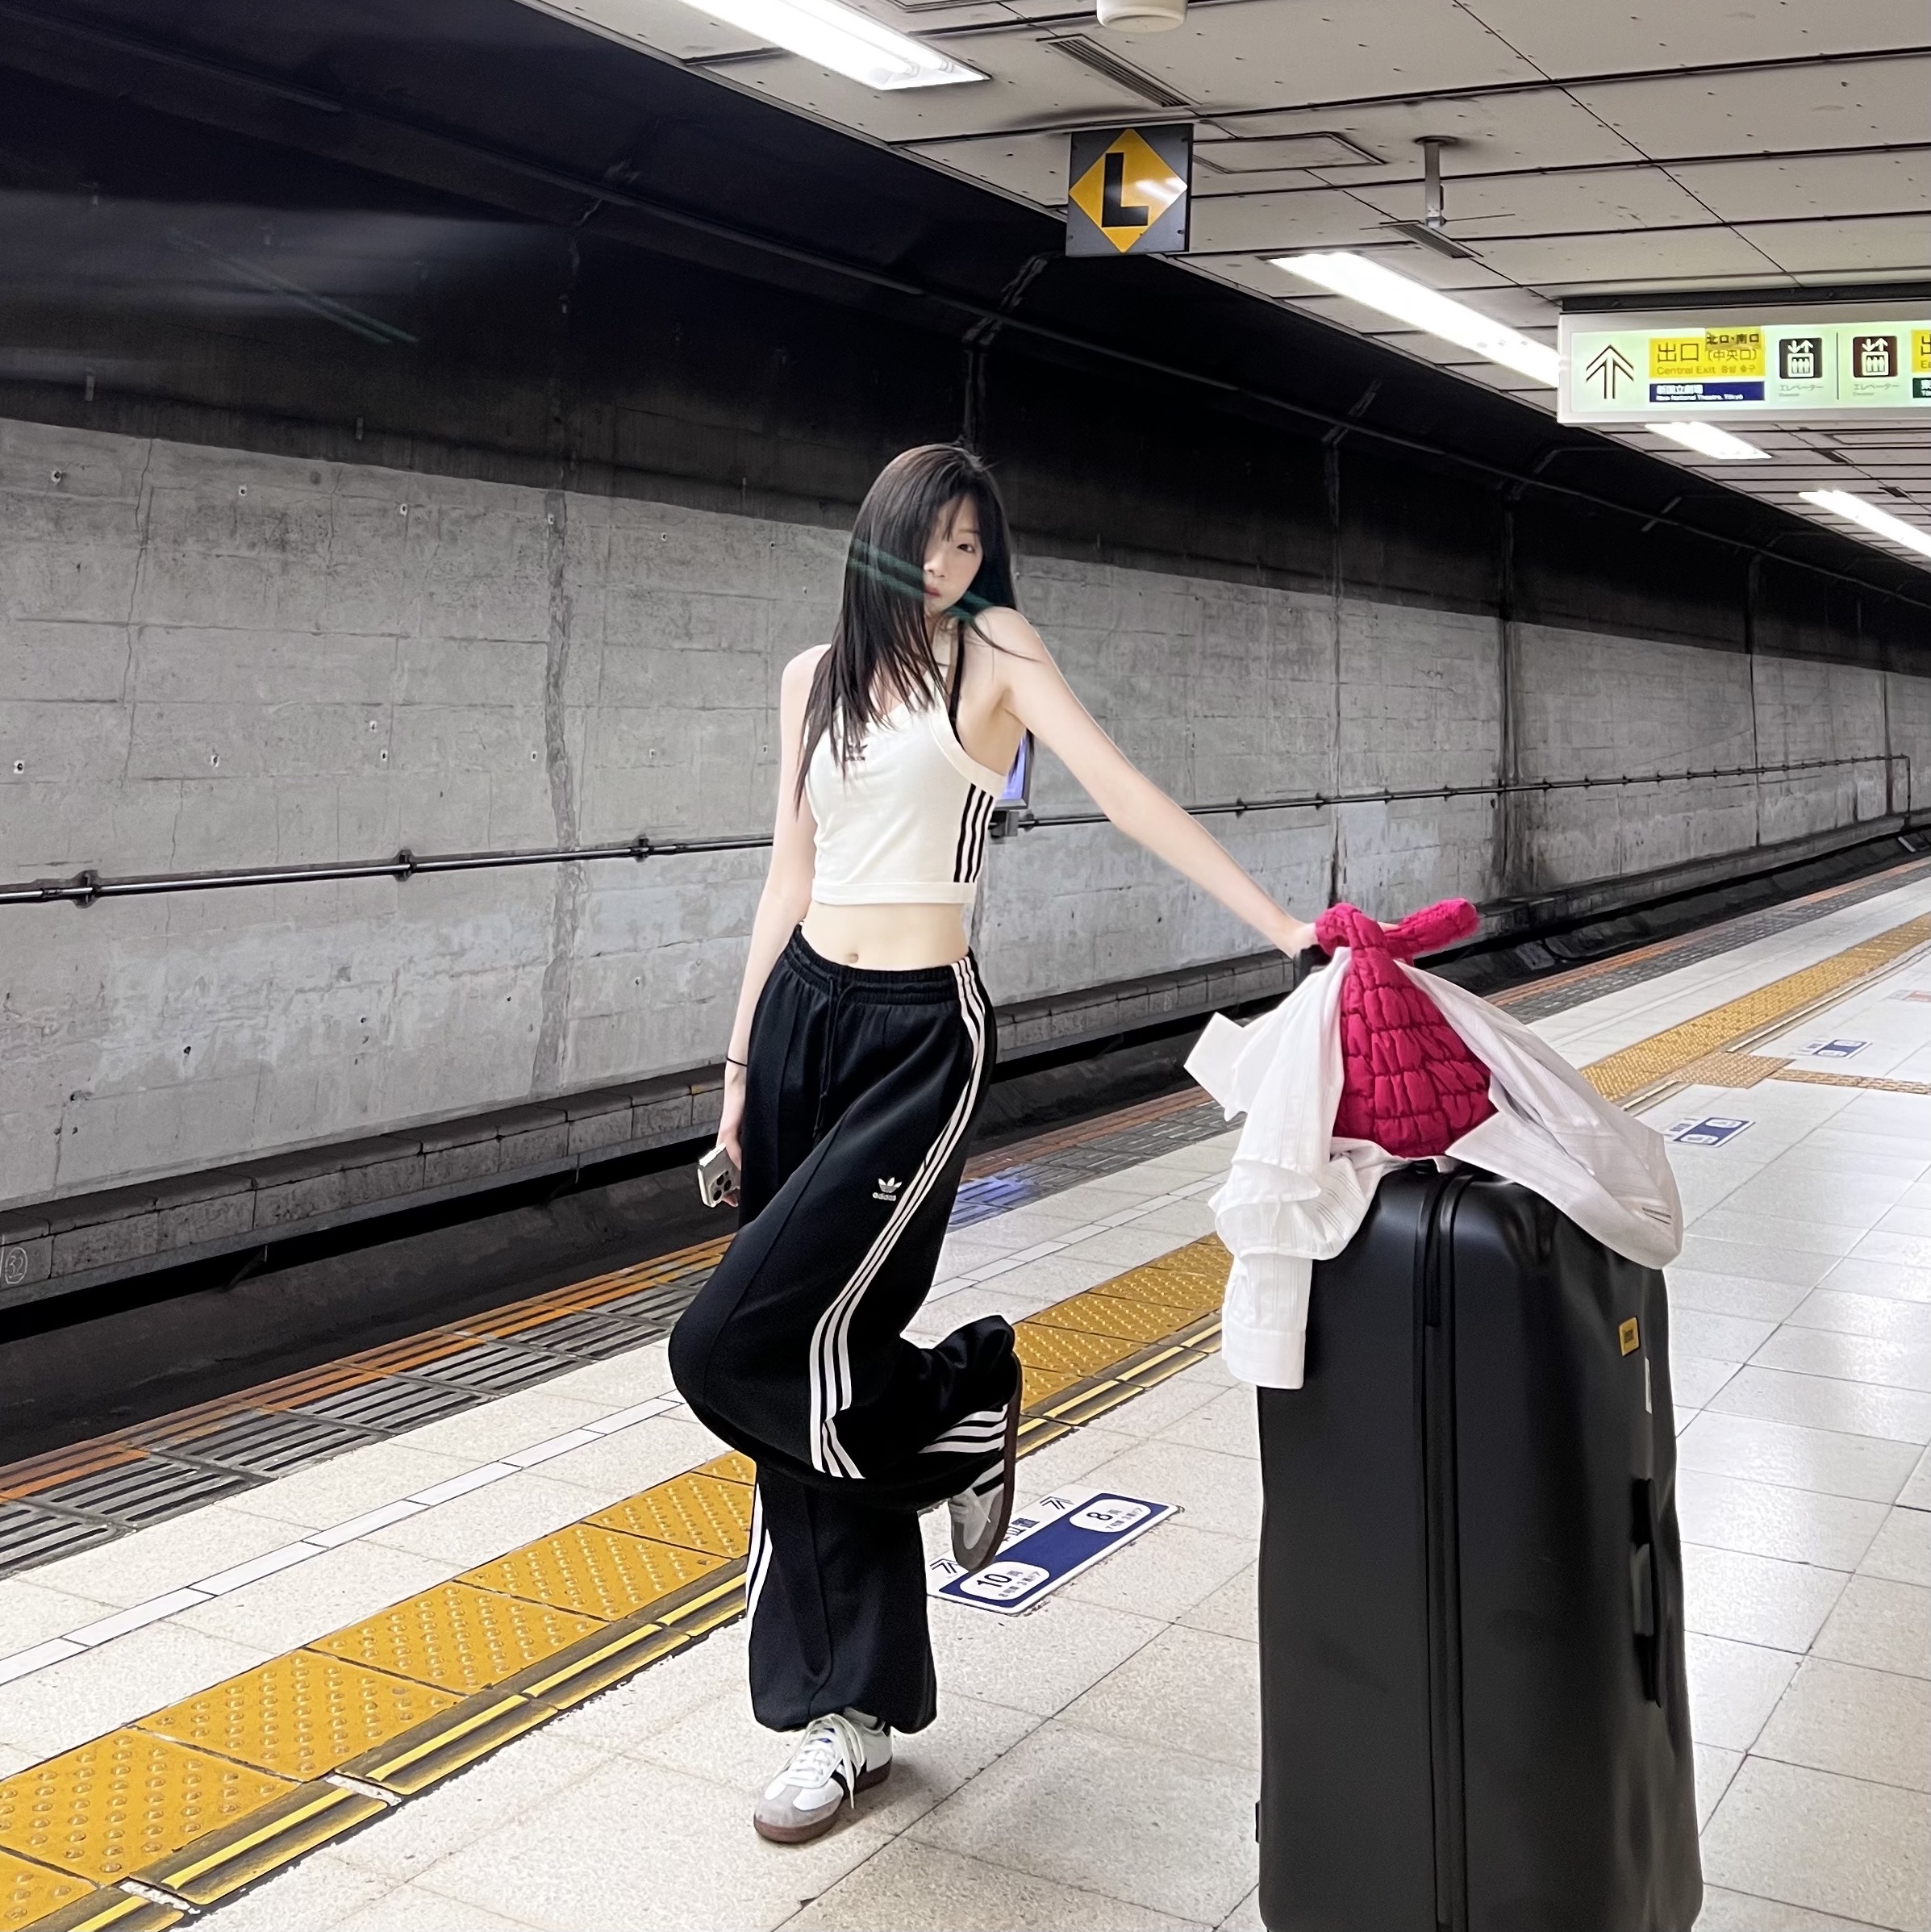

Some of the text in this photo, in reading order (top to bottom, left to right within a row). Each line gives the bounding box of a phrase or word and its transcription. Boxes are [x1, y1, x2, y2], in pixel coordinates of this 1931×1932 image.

[1102, 152, 1149, 228] L
[1658, 342, 1700, 362] 出口
[1657, 365, 1716, 375] Central Exit
